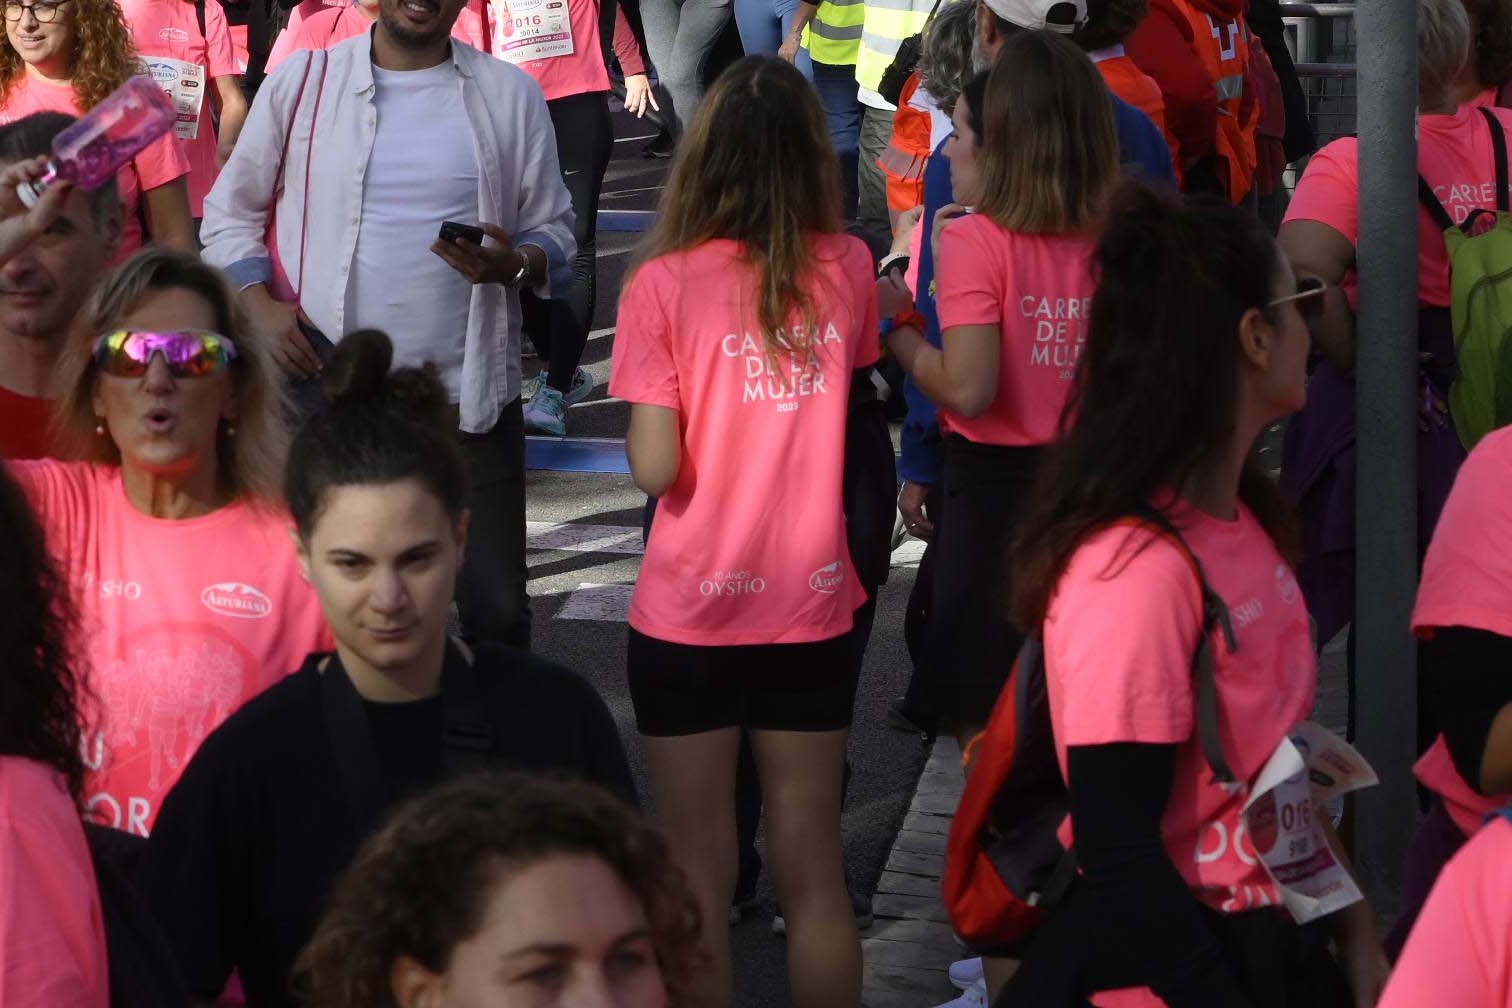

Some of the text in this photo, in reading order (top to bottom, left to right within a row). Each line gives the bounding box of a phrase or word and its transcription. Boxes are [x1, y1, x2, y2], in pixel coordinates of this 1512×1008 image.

[516, 14, 542, 28] 016
[721, 321, 841, 358] CARERA
[1036, 320, 1067, 343] DE
[743, 371, 827, 404] MUJER
[700, 578, 765, 596] OYSHO
[206, 591, 267, 613] ASTURIANA
